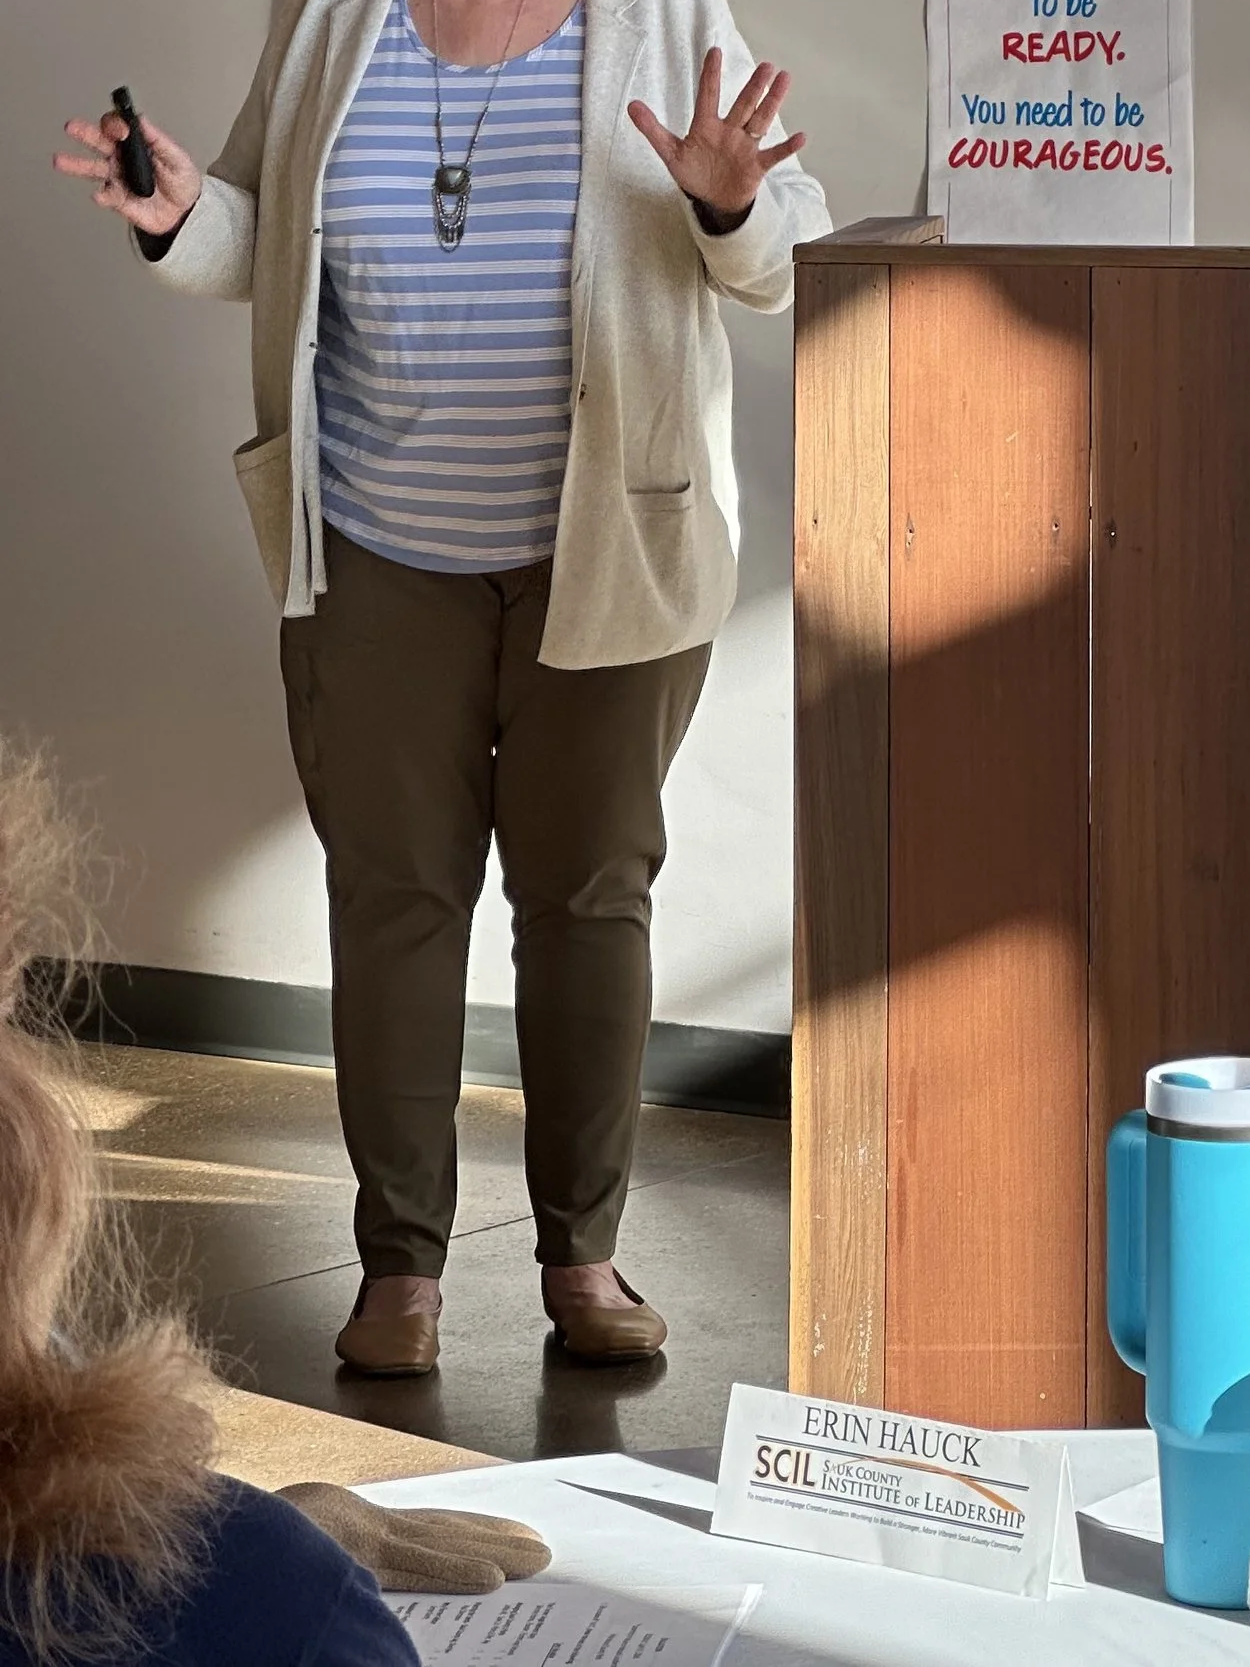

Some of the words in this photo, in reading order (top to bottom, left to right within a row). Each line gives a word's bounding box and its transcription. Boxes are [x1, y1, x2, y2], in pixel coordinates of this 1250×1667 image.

[1002, 30, 1126, 65] READY.
[961, 93, 1006, 126] You
[1016, 90, 1073, 127] need
[1080, 97, 1106, 126] to
[1115, 92, 1145, 127] be
[948, 137, 1173, 175] COURAGEOUS.
[803, 1406, 873, 1446] ERIN
[879, 1420, 983, 1468] HAUCK
[755, 1444, 816, 1487] SCIL
[855, 1466, 903, 1487] COUNTY
[821, 1473, 901, 1505] INSTITUTE
[905, 1495, 920, 1509] OF
[924, 1491, 1026, 1529] LEADERSHIP
